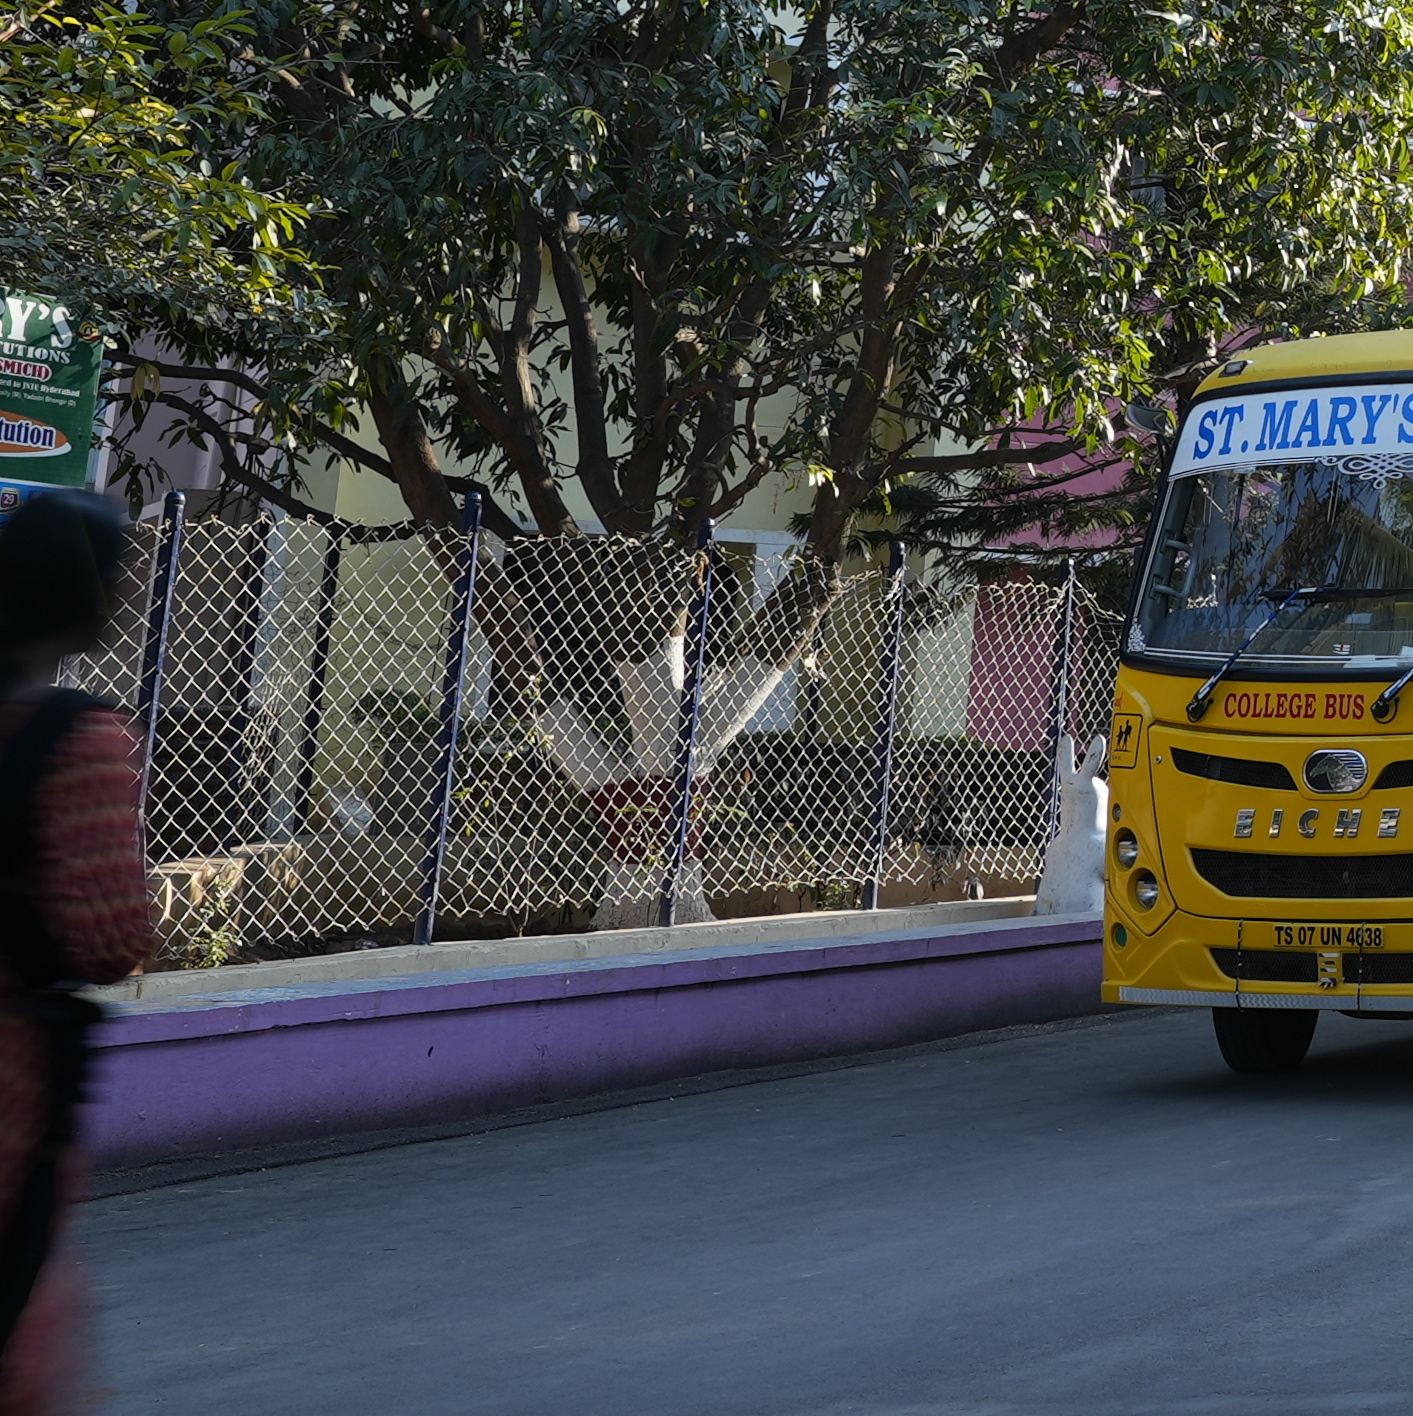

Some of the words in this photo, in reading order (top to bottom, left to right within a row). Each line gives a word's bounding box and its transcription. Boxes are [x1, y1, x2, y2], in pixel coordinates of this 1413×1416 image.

[1224, 692, 1317, 719] COLLEGE
[1323, 693, 1365, 720] BUS
[1274, 926, 1294, 945] TS
[1298, 926, 1316, 946] 07
[1320, 926, 1342, 946] UN
[1346, 927, 1382, 947] 4638
